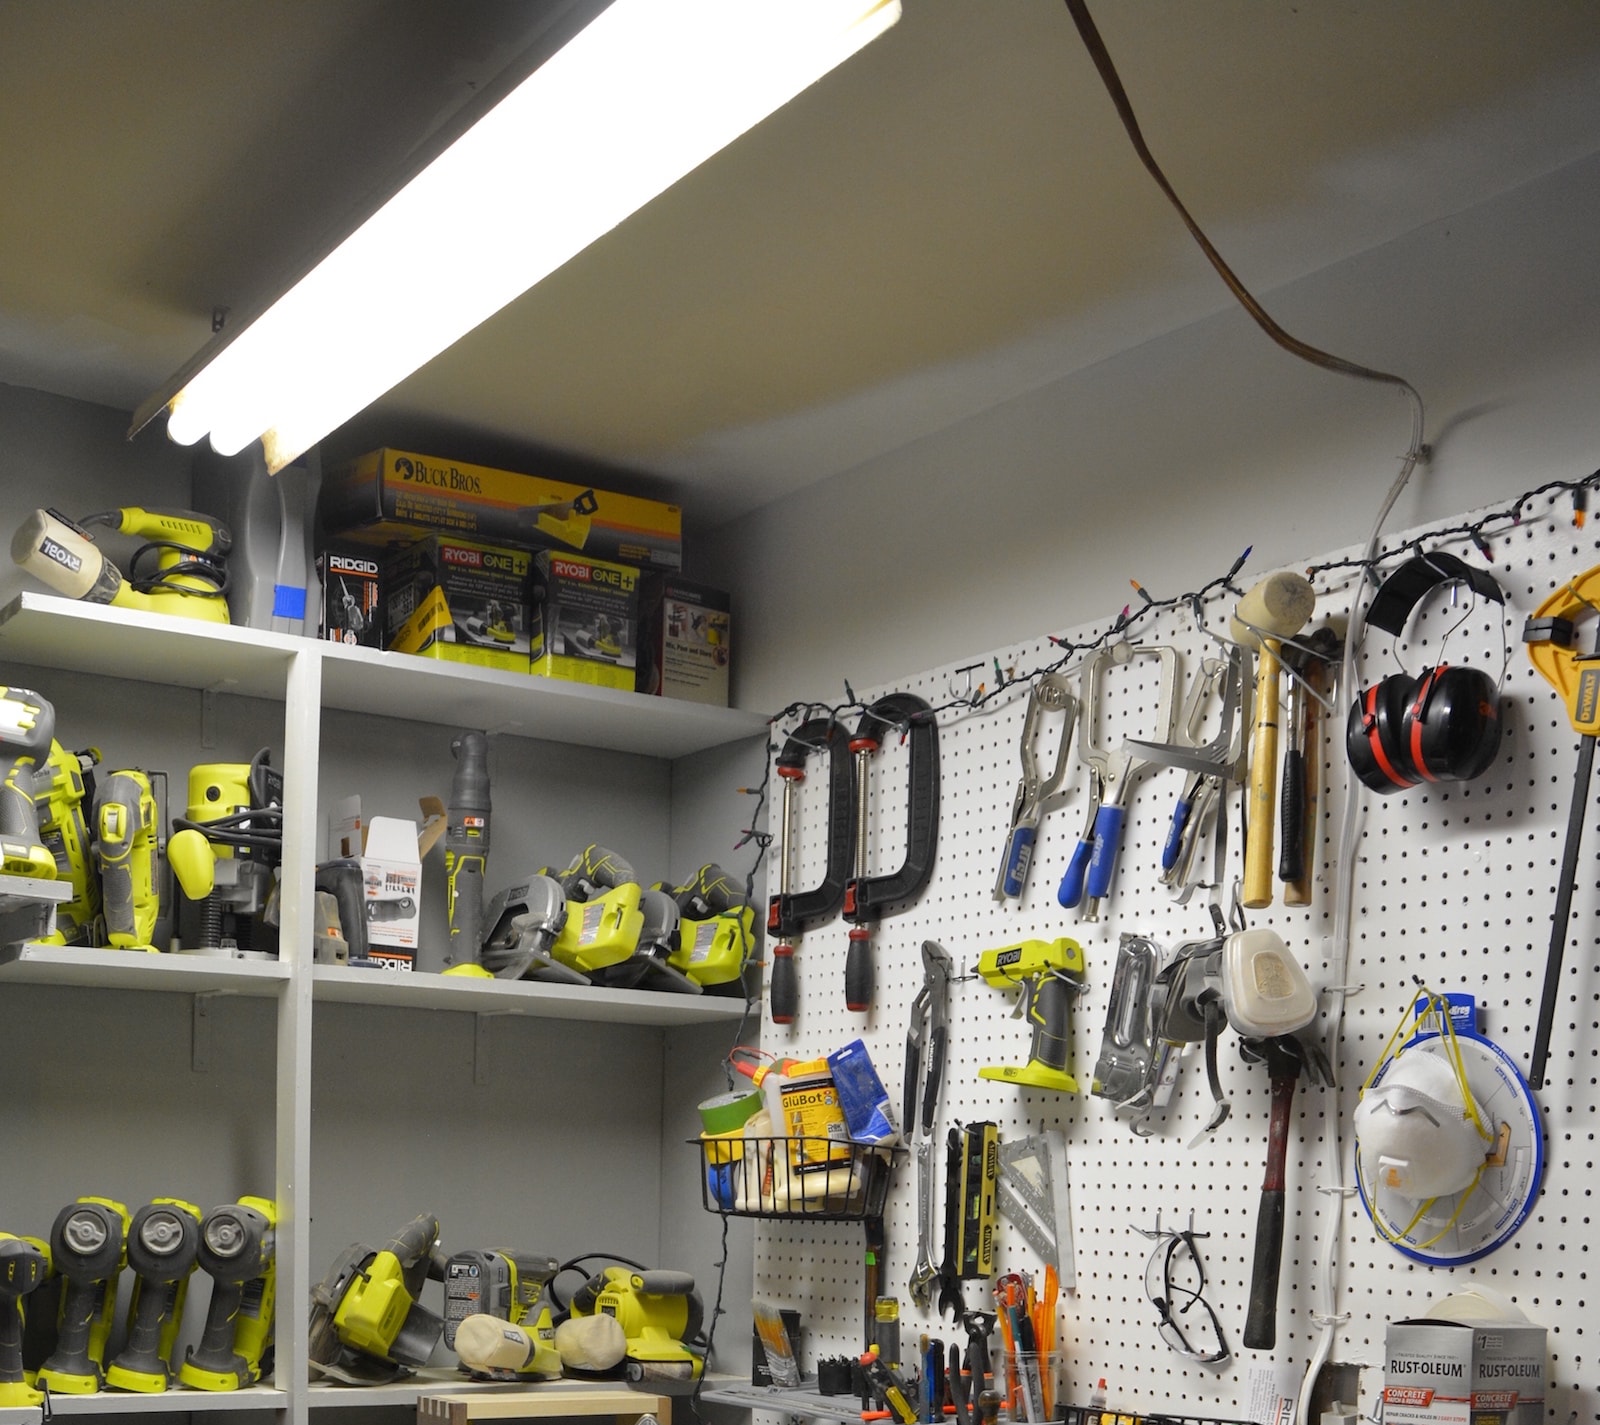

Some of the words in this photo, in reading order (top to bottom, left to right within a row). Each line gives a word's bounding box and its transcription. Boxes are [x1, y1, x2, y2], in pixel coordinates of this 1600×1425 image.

[414, 461, 448, 488] BUCK
[450, 468, 482, 495] BROS.
[44, 539, 80, 571] RYOBI
[444, 548, 480, 564] RYOBI
[330, 556, 378, 574] RIDGID
[555, 562, 589, 579] RYOBI
[997, 951, 1020, 965] RYOBI
[783, 1092, 823, 1108] GlüBot
[1387, 1389, 1426, 1399] CONCRETE
[1475, 1394, 1512, 1403] CONCRETE
